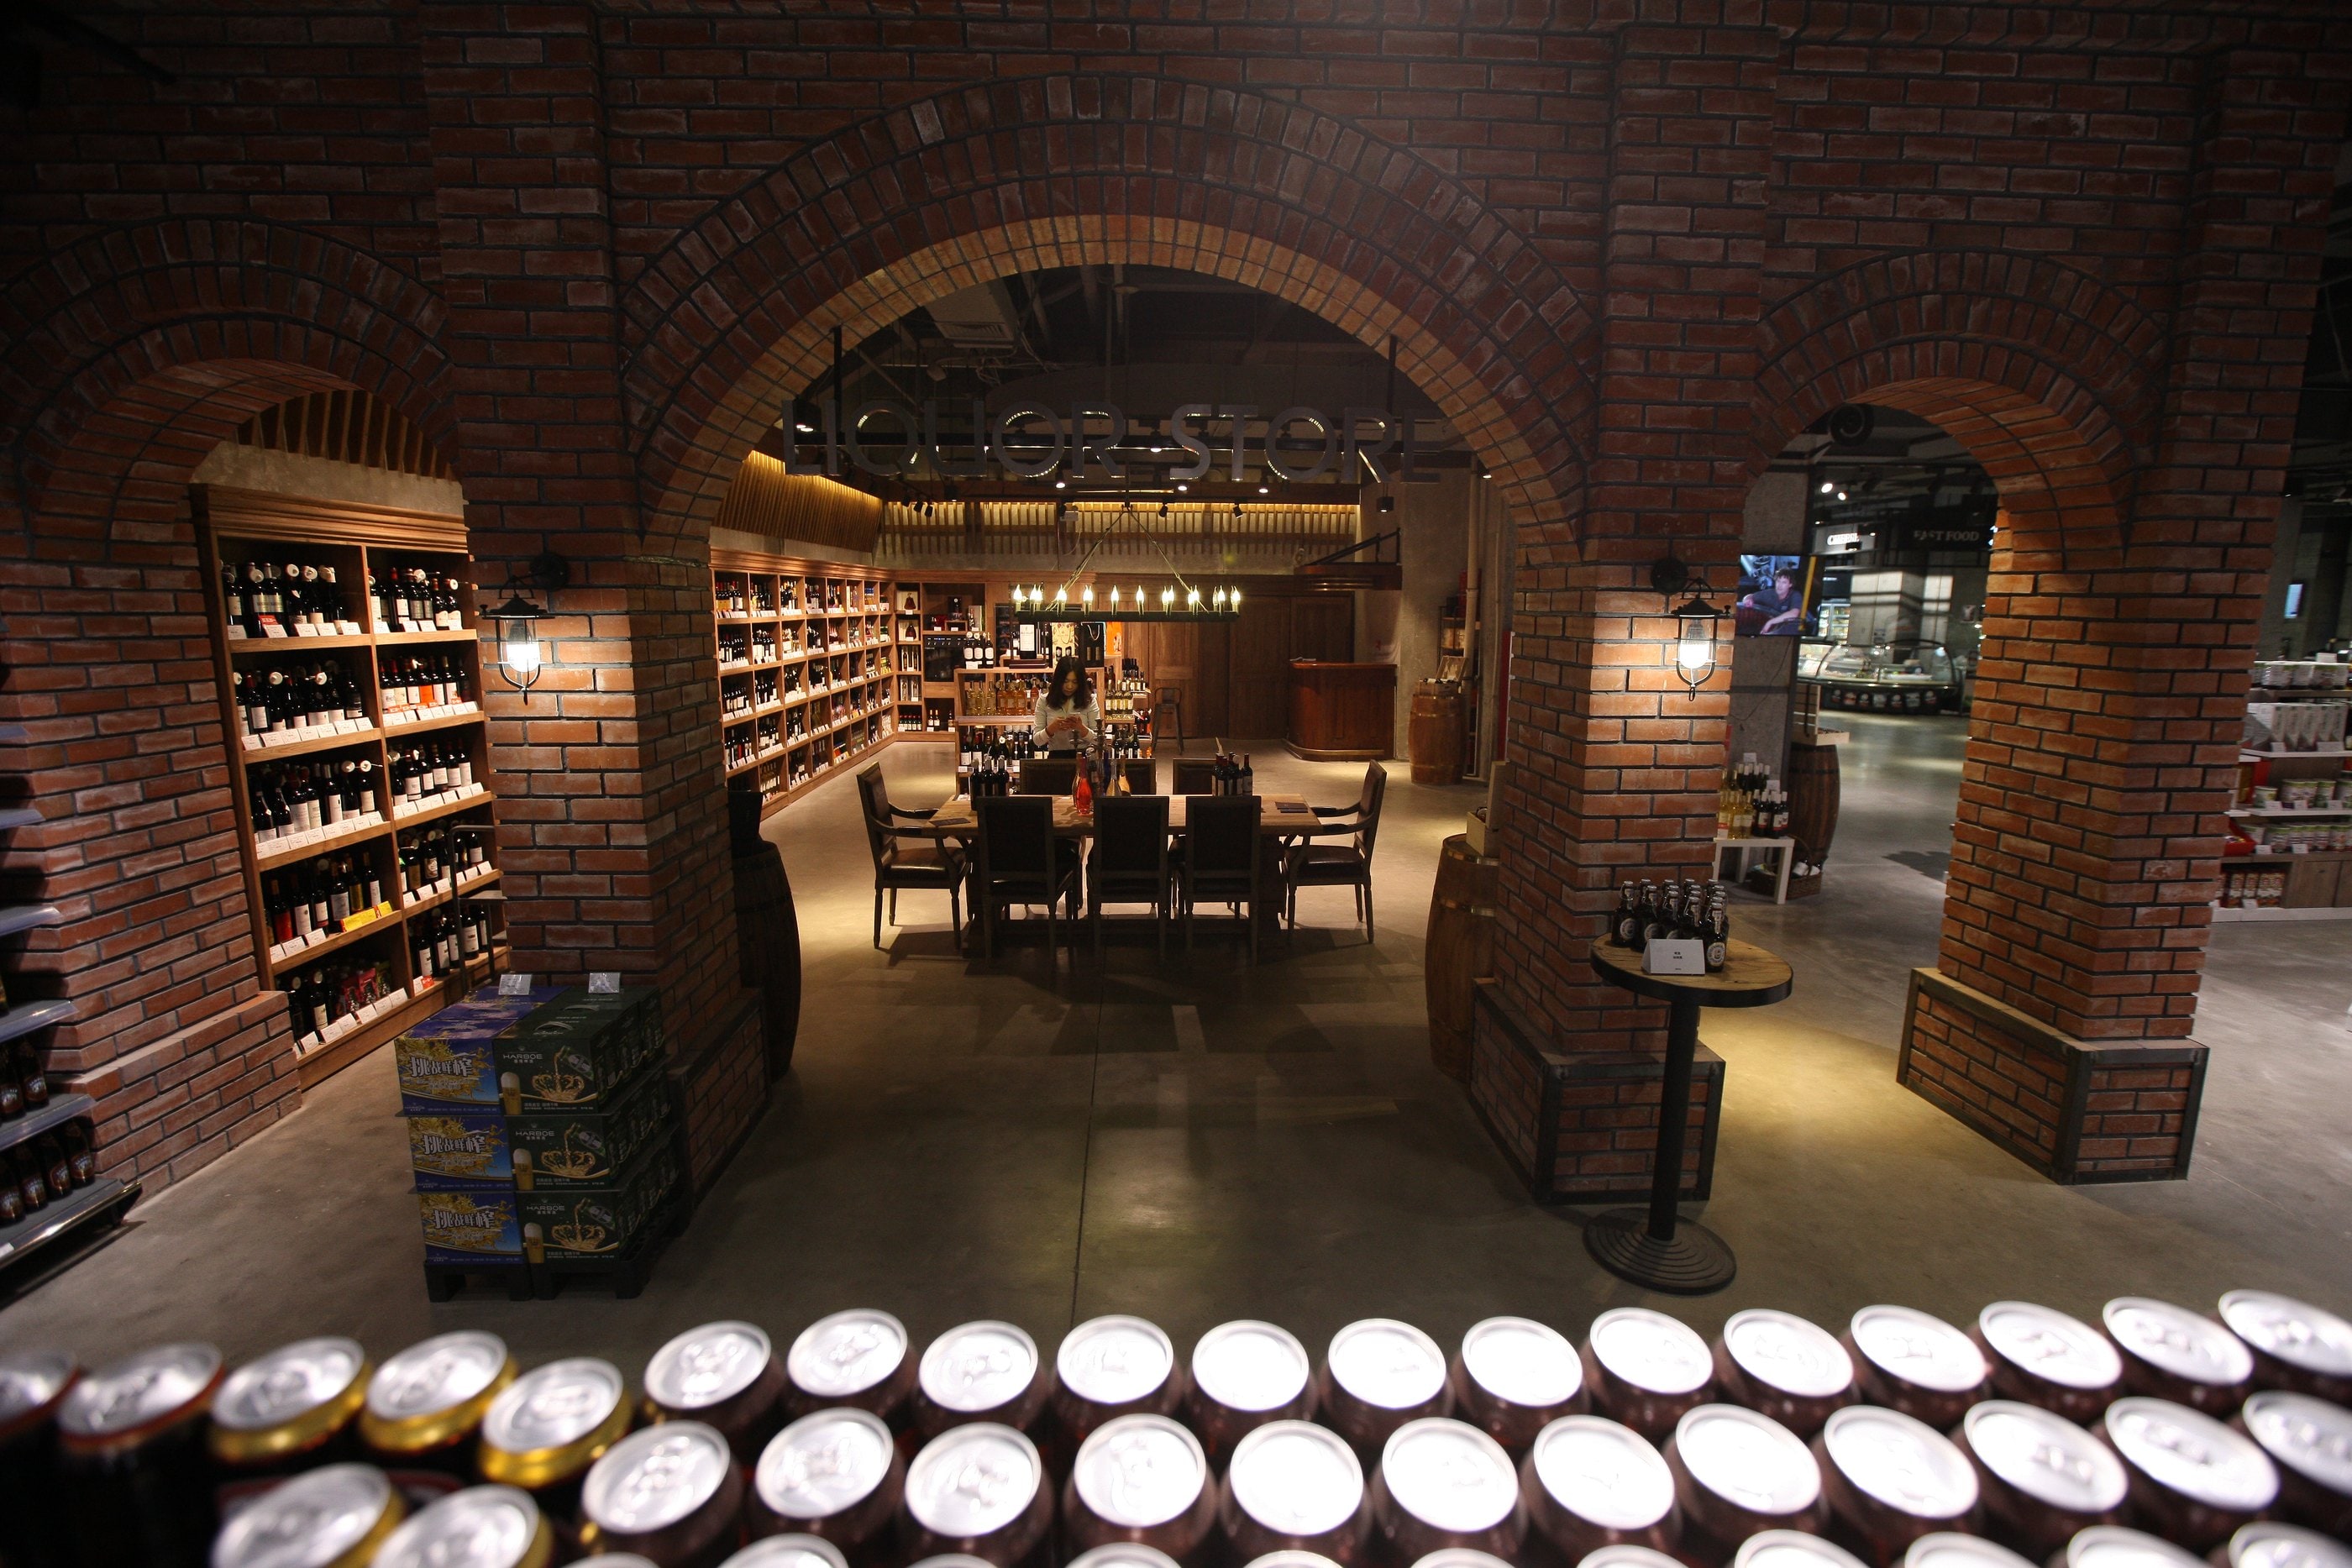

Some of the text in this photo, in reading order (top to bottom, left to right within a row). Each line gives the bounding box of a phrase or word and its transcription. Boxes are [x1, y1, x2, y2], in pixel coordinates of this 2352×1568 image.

[782, 399, 1441, 485] LIQUOR STORE
[1945, 530, 1980, 542] FOOD
[409, 1056, 474, 1078] 挑战鲜榨
[422, 1133, 486, 1155] 挑战鲜榨
[433, 1209, 496, 1230] 挑战鲜榨
